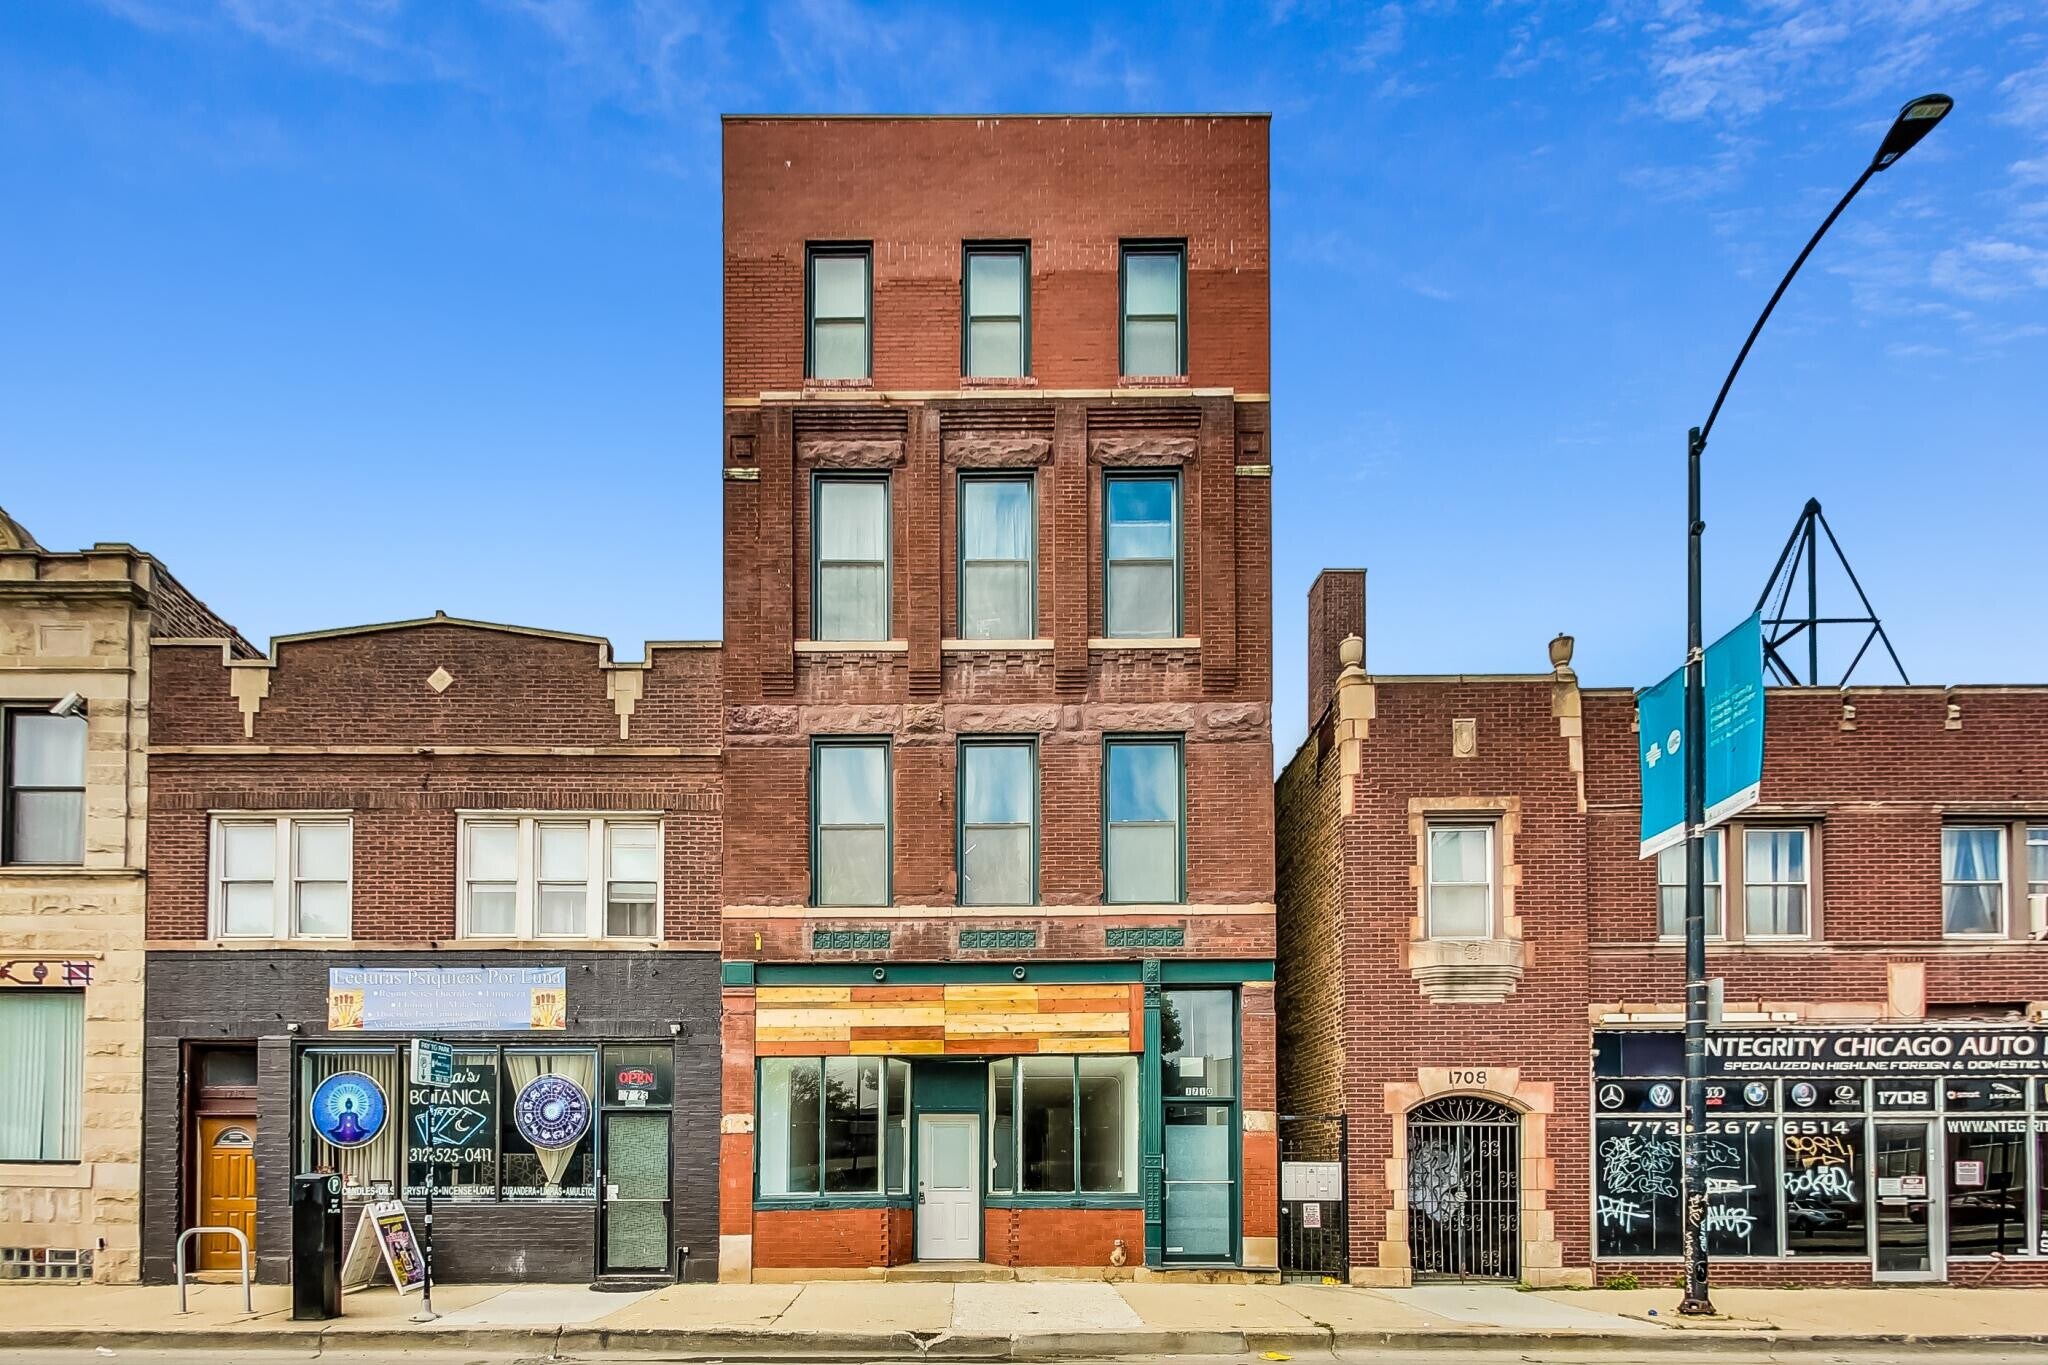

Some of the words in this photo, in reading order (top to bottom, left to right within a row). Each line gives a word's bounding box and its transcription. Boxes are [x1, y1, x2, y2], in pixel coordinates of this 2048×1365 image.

[334, 969, 401, 985] Lecturas
[408, 969, 482, 989] Psiquicas
[488, 969, 515, 984] Por
[521, 969, 561, 984] Luna
[438, 1045, 450, 1053] PARK
[1705, 1037, 1826, 1057] NTEGRITY
[1834, 1036, 1952, 1057] CHICAGO
[1957, 1036, 2036, 1056] AUTO
[1723, 1061, 1810, 1071] SPECIALIZED
[1812, 1061, 1824, 1070] IN
[1827, 1060, 1890, 1070] HIGHLINE
[1890, 1060, 1950, 1070] FOREIGN
[1952, 1060, 1964, 1069] &
[1967, 1060, 2041, 1069] DOMESTIC
[450, 1067, 480, 1084] a's
[618, 1072, 654, 1084] OPEN
[1448, 1071, 1488, 1085] 1708
[409, 1089, 491, 1105] BOTANICA
[1186, 1087, 1212, 1096] 1710
[1878, 1091, 1928, 1105] 1708
[1628, 1121, 1679, 1134] 773
[1783, 1121, 1850, 1135] 6514
[409, 1148, 492, 1163] 312525-0411
[403, 1186, 438, 1196] CRYSTS
[441, 1186, 473, 1195] INCENSE
[475, 1186, 495, 1195] LOVE
[501, 1186, 536, 1196] CURANDERA
